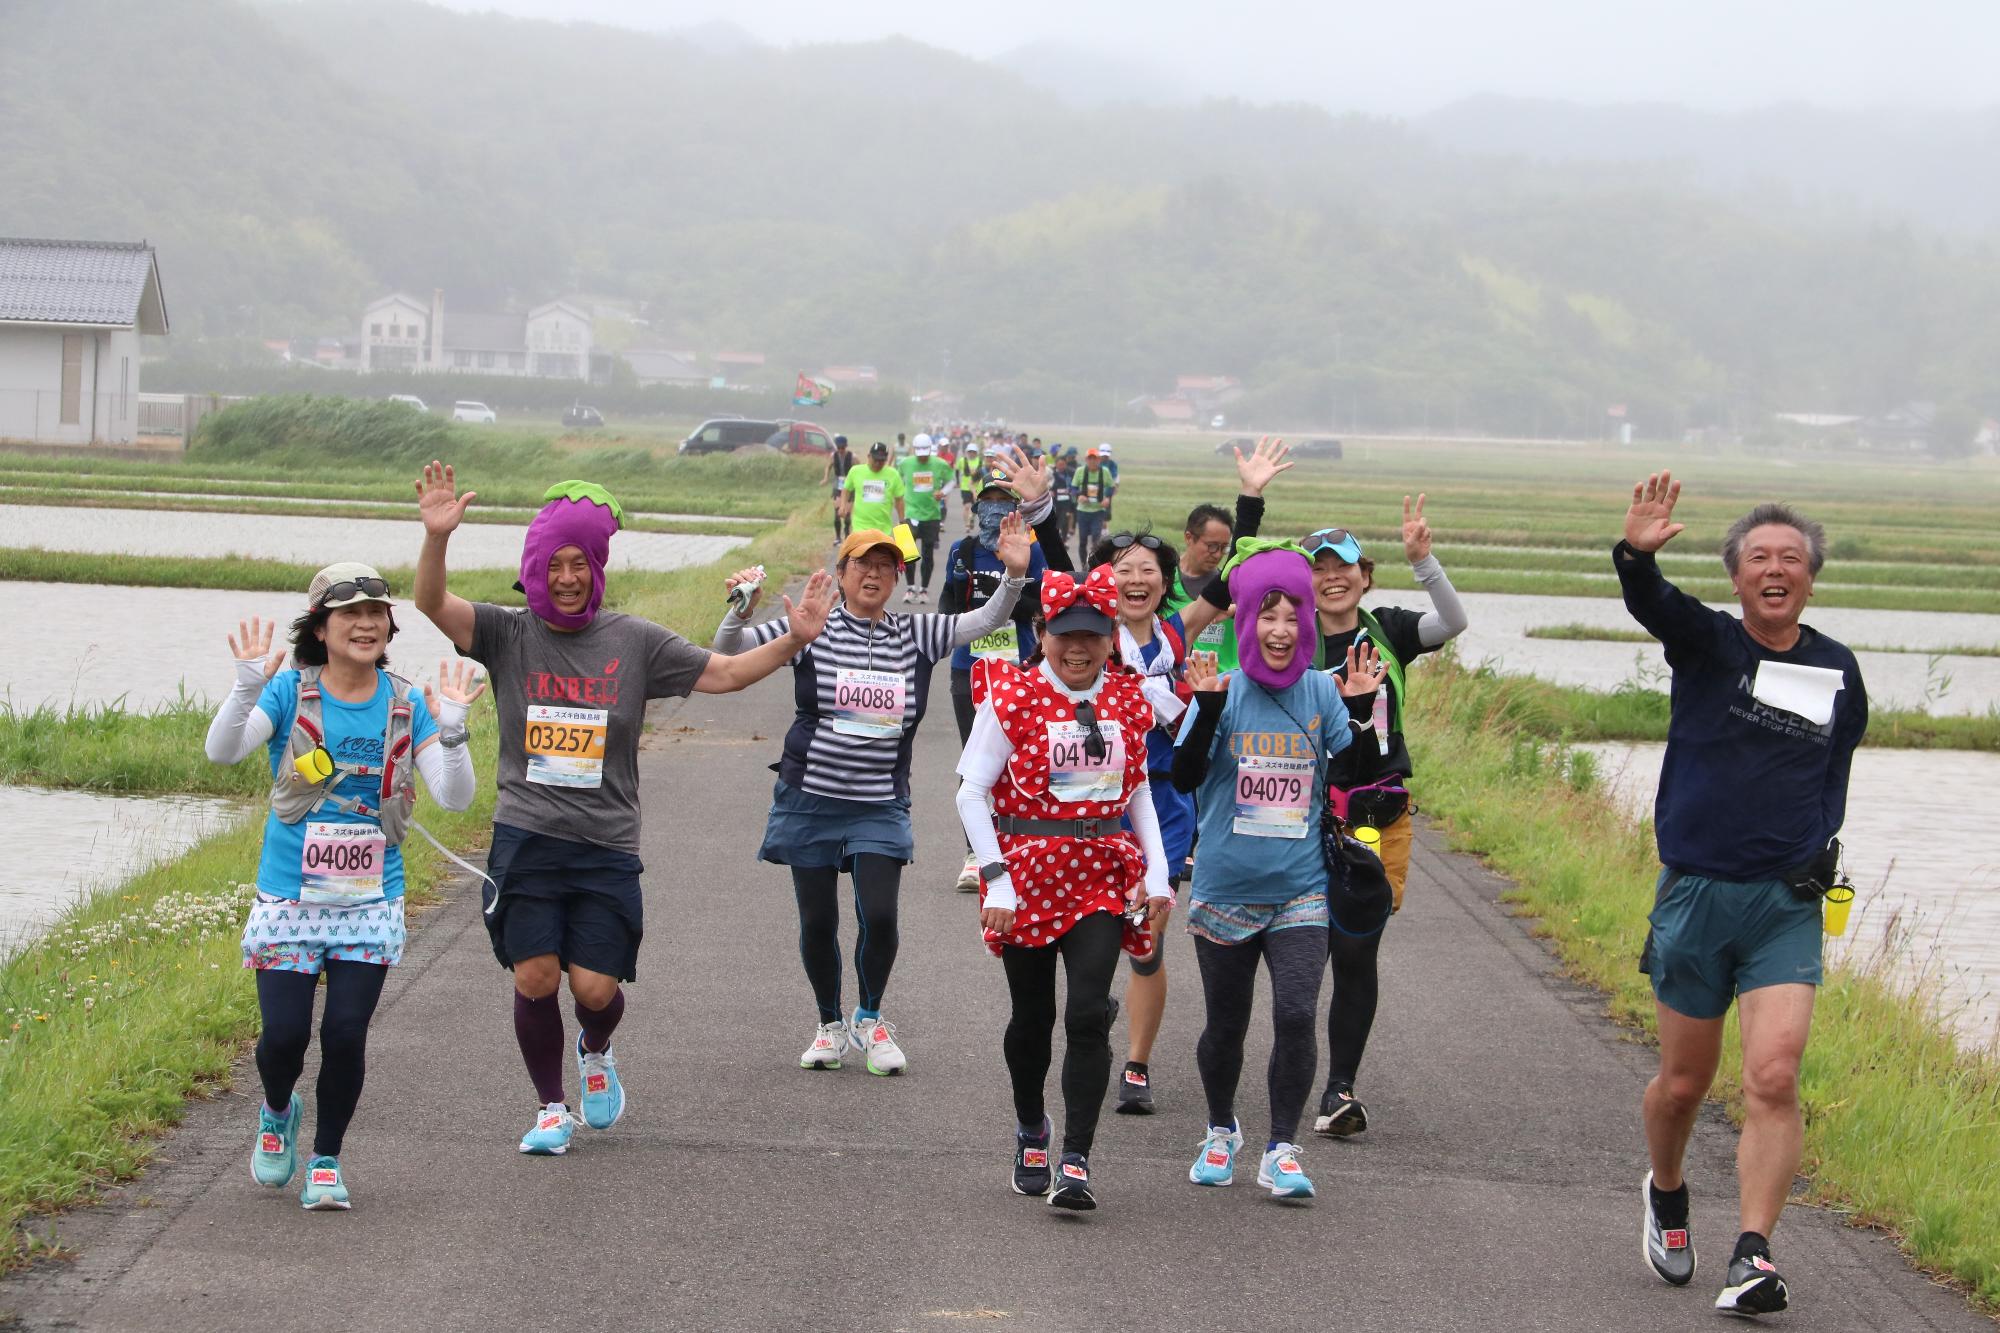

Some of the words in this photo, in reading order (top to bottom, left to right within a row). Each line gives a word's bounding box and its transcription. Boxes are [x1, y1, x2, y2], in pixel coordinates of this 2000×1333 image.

[972, 632, 1010, 649] 02068
[537, 673, 596, 703] KOBE
[839, 685, 895, 710] 04088
[1729, 704, 1760, 724] NEVER
[1760, 718, 1784, 732] STOP
[529, 725, 594, 753] 03257
[1242, 733, 1301, 758] KOBE
[1240, 775, 1301, 803] 04079
[306, 843, 373, 871] 04086
